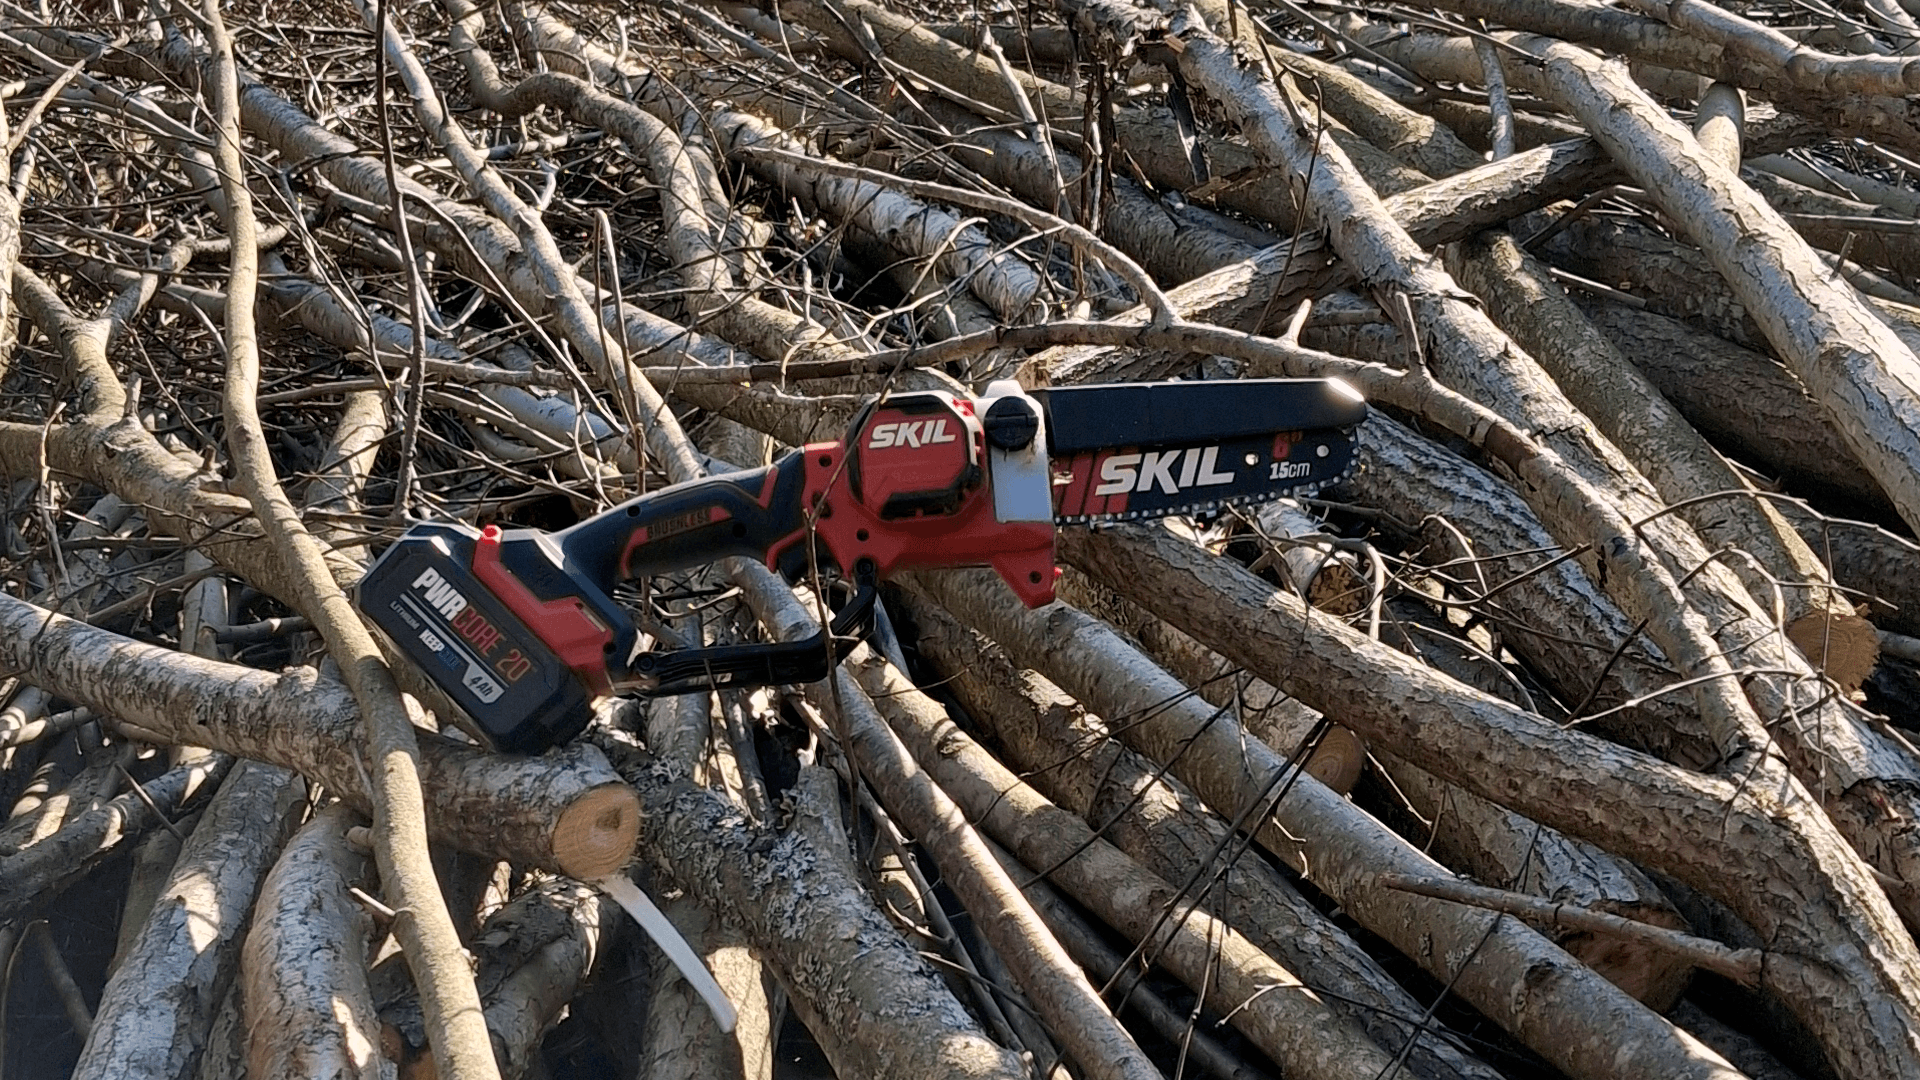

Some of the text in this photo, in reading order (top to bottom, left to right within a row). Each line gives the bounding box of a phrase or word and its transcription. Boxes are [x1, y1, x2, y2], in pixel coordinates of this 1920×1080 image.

[868, 419, 956, 449] SKIL
[1095, 446, 1235, 496] SKIL
[1269, 461, 1310, 480] 15cm
[496, 648, 531, 682] 20
